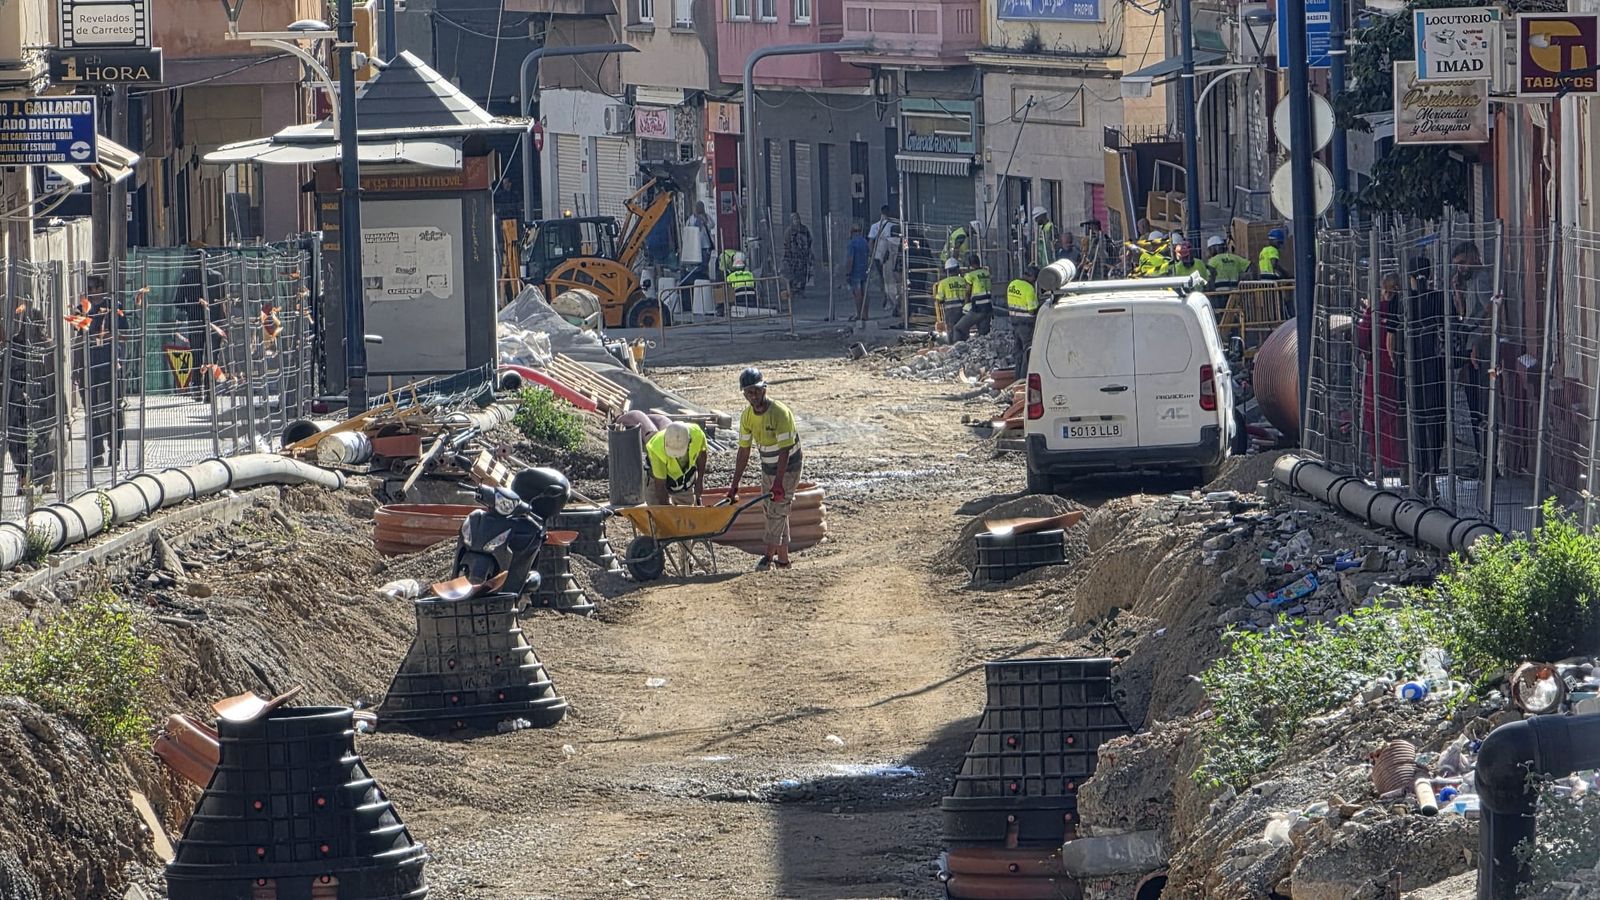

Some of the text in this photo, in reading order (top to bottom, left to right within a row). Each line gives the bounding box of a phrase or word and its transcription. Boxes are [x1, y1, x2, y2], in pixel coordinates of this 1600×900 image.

[1074, 3, 1093, 16] PROPIO
[80, 14, 130, 23] Revelados
[1426, 14, 1491, 26] LOCUTORIO
[76, 25, 134, 35] de Carretes
[61, 56, 151, 81] 1 HORA
[1436, 59, 1484, 73] IMAD
[1524, 77, 1594, 88] TABAOS
[24, 101, 92, 115] GALLARDO
[29, 117, 73, 130] DIGITAL
[10, 131, 42, 141] CARRETES
[1070, 424, 1120, 437] 5013 LLB
